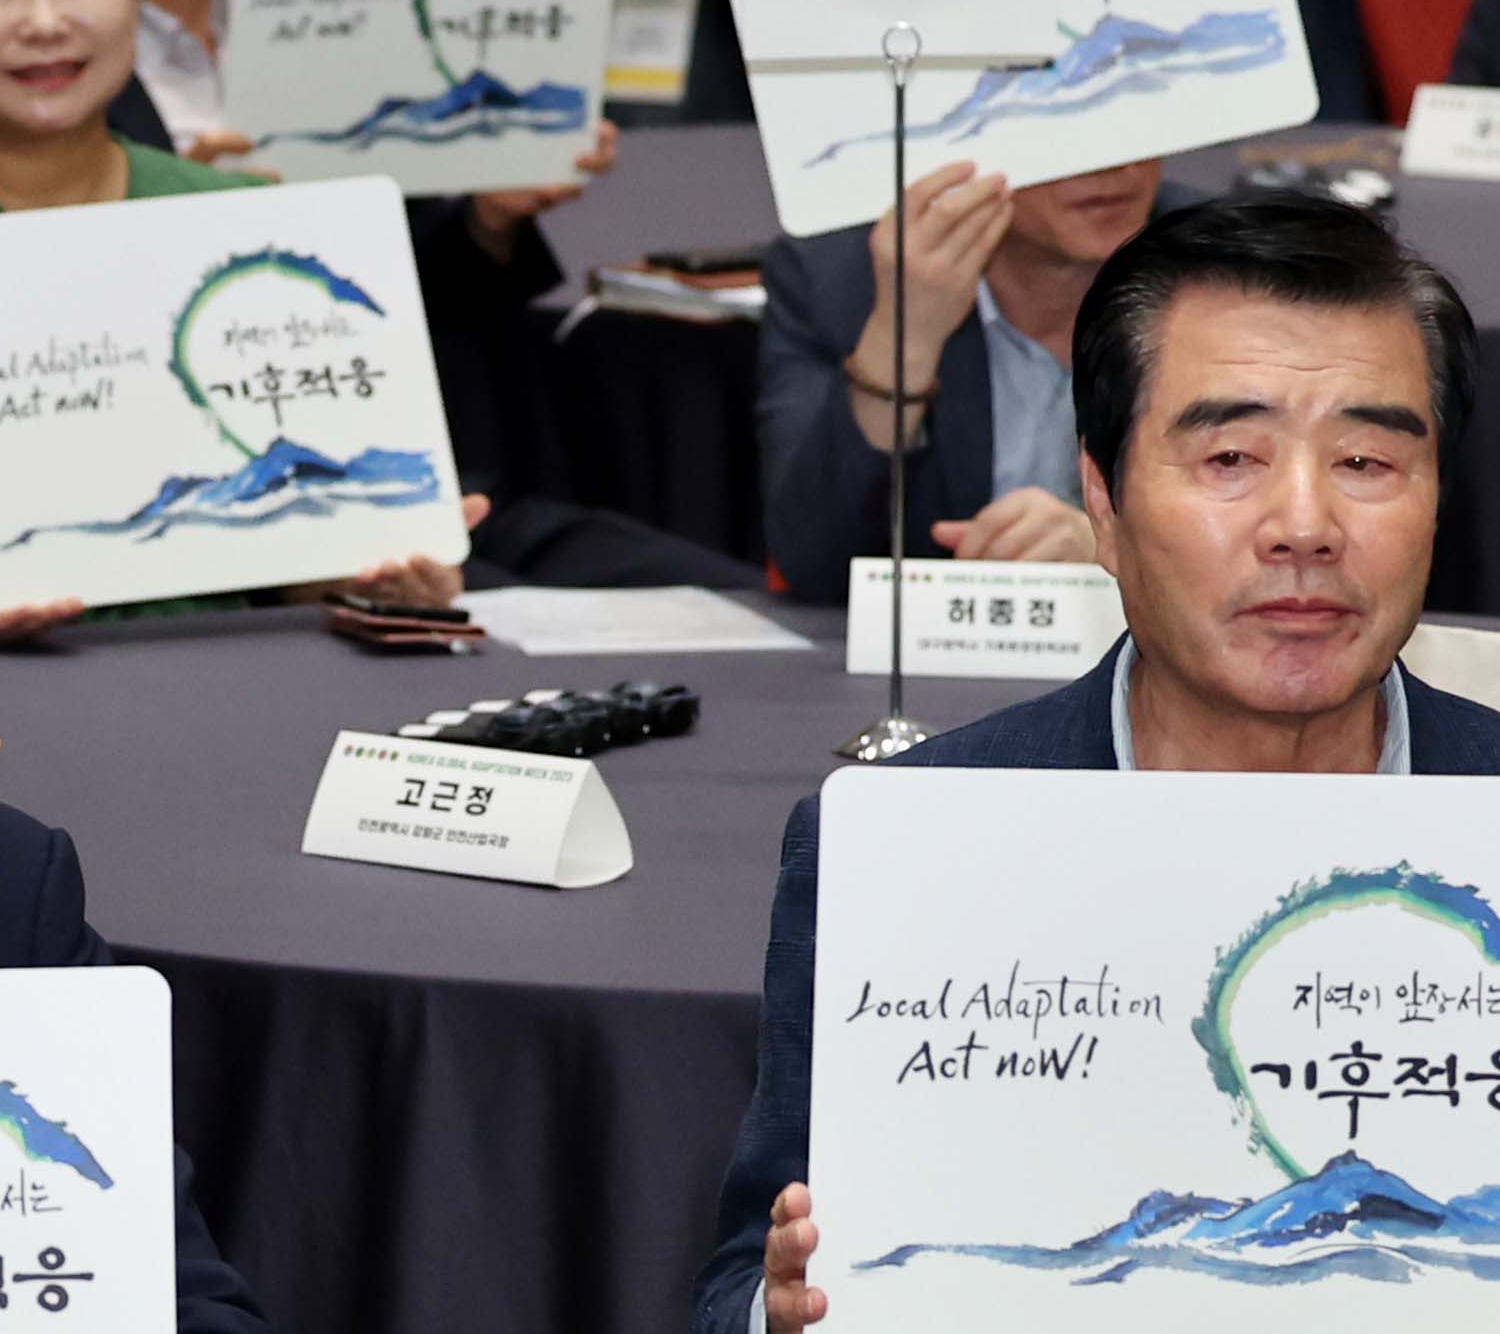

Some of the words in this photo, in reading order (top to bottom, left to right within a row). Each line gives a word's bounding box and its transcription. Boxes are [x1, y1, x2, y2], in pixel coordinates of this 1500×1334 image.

[209, 357, 388, 426] 기후적응
[396, 778, 494, 816] 고근정
[847, 979, 951, 1023] Local
[961, 960, 1167, 1039] Adaptation
[1293, 970, 1381, 1029] 지역이
[897, 1029, 988, 1086] Act
